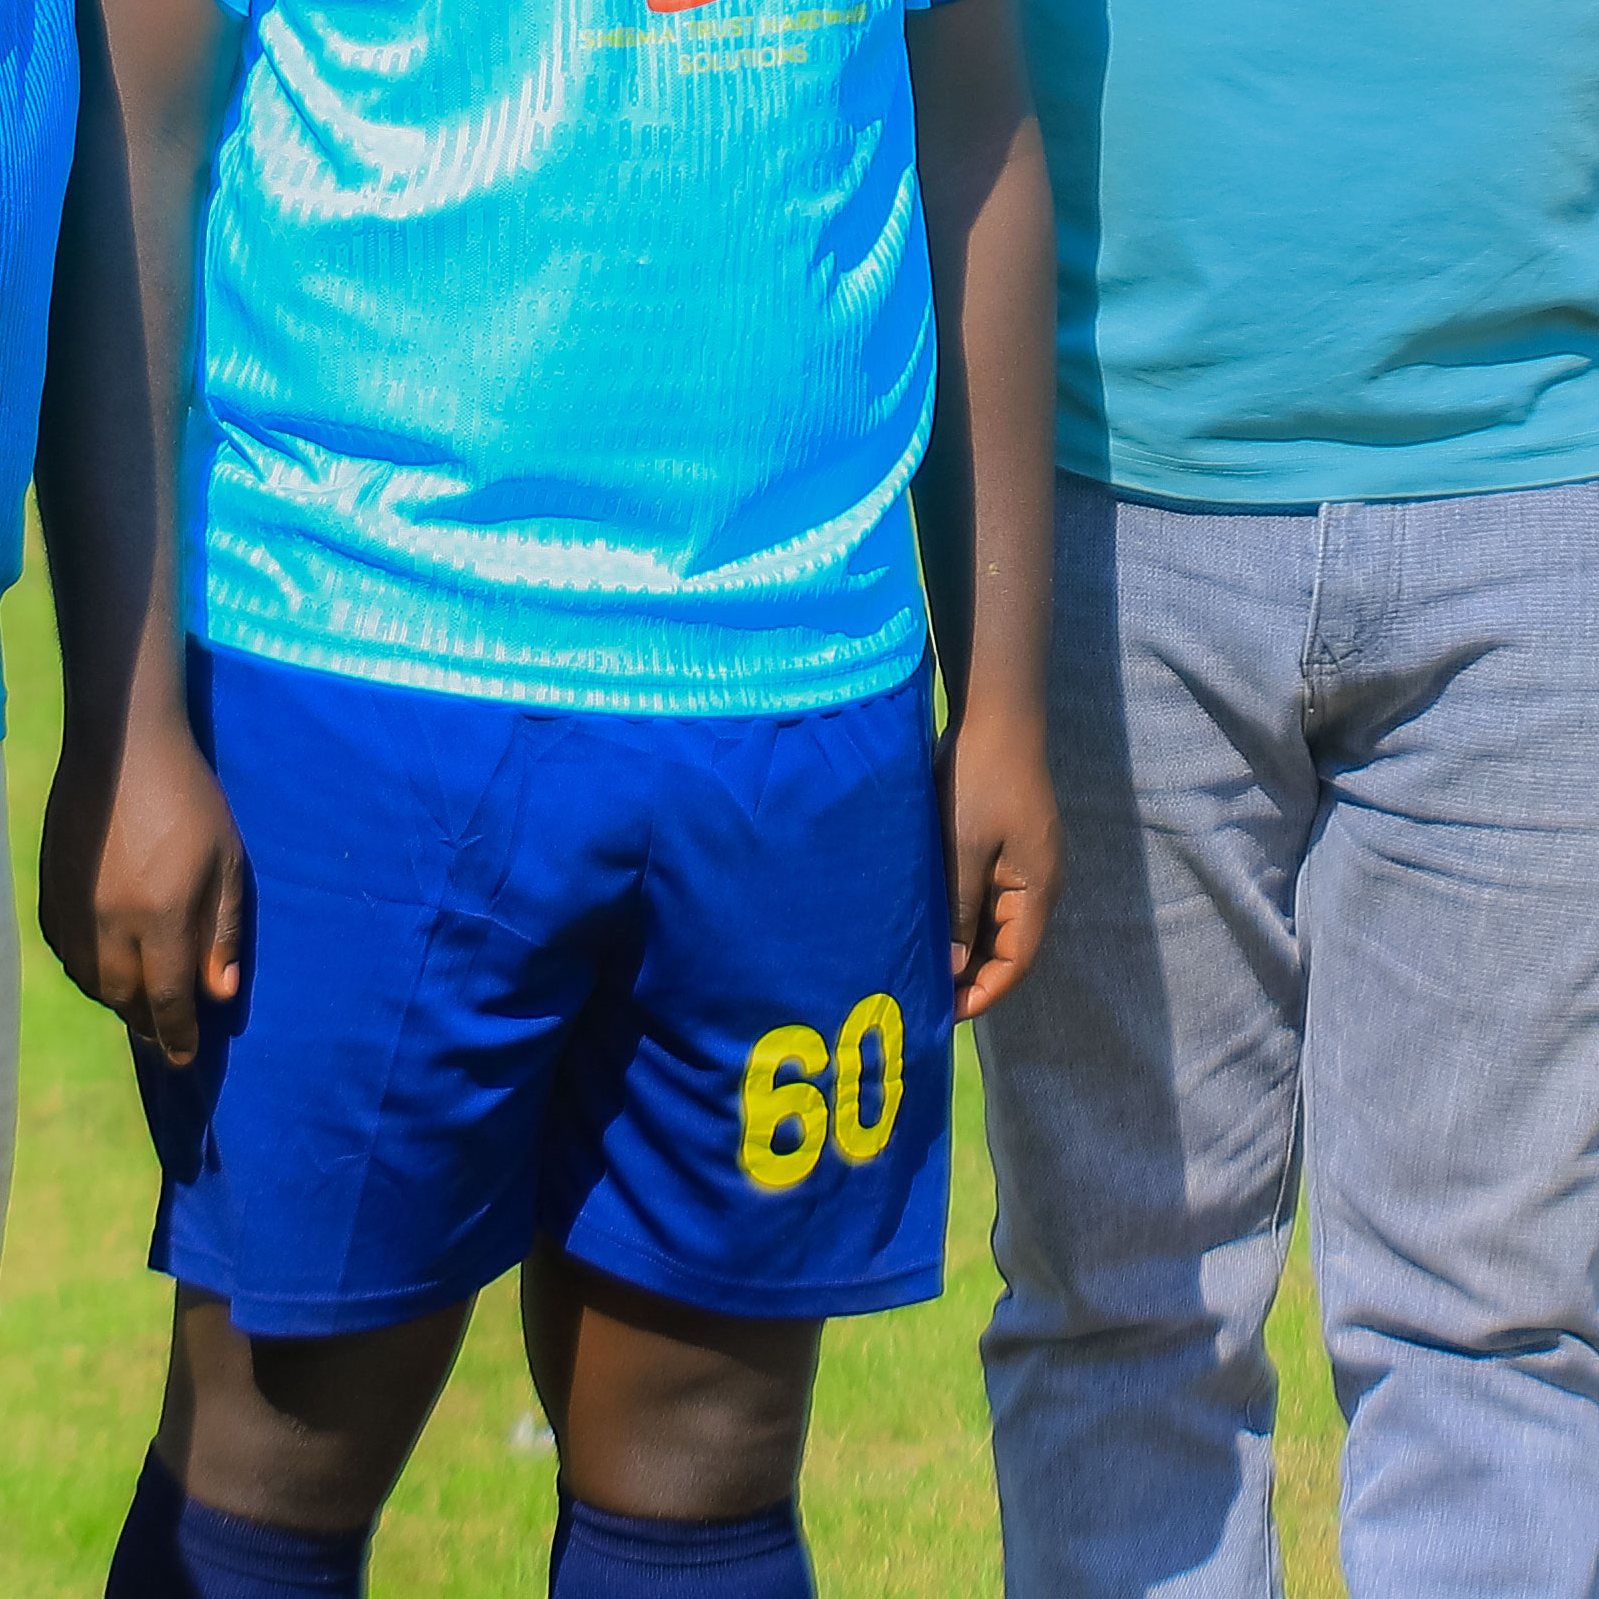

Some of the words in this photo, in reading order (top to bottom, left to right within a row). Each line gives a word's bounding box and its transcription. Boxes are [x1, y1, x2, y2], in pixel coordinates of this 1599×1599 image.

[684, 15, 754, 39] TRUST
[677, 43, 809, 75] SOLUTIONS
[741, 991, 904, 1189] 60
